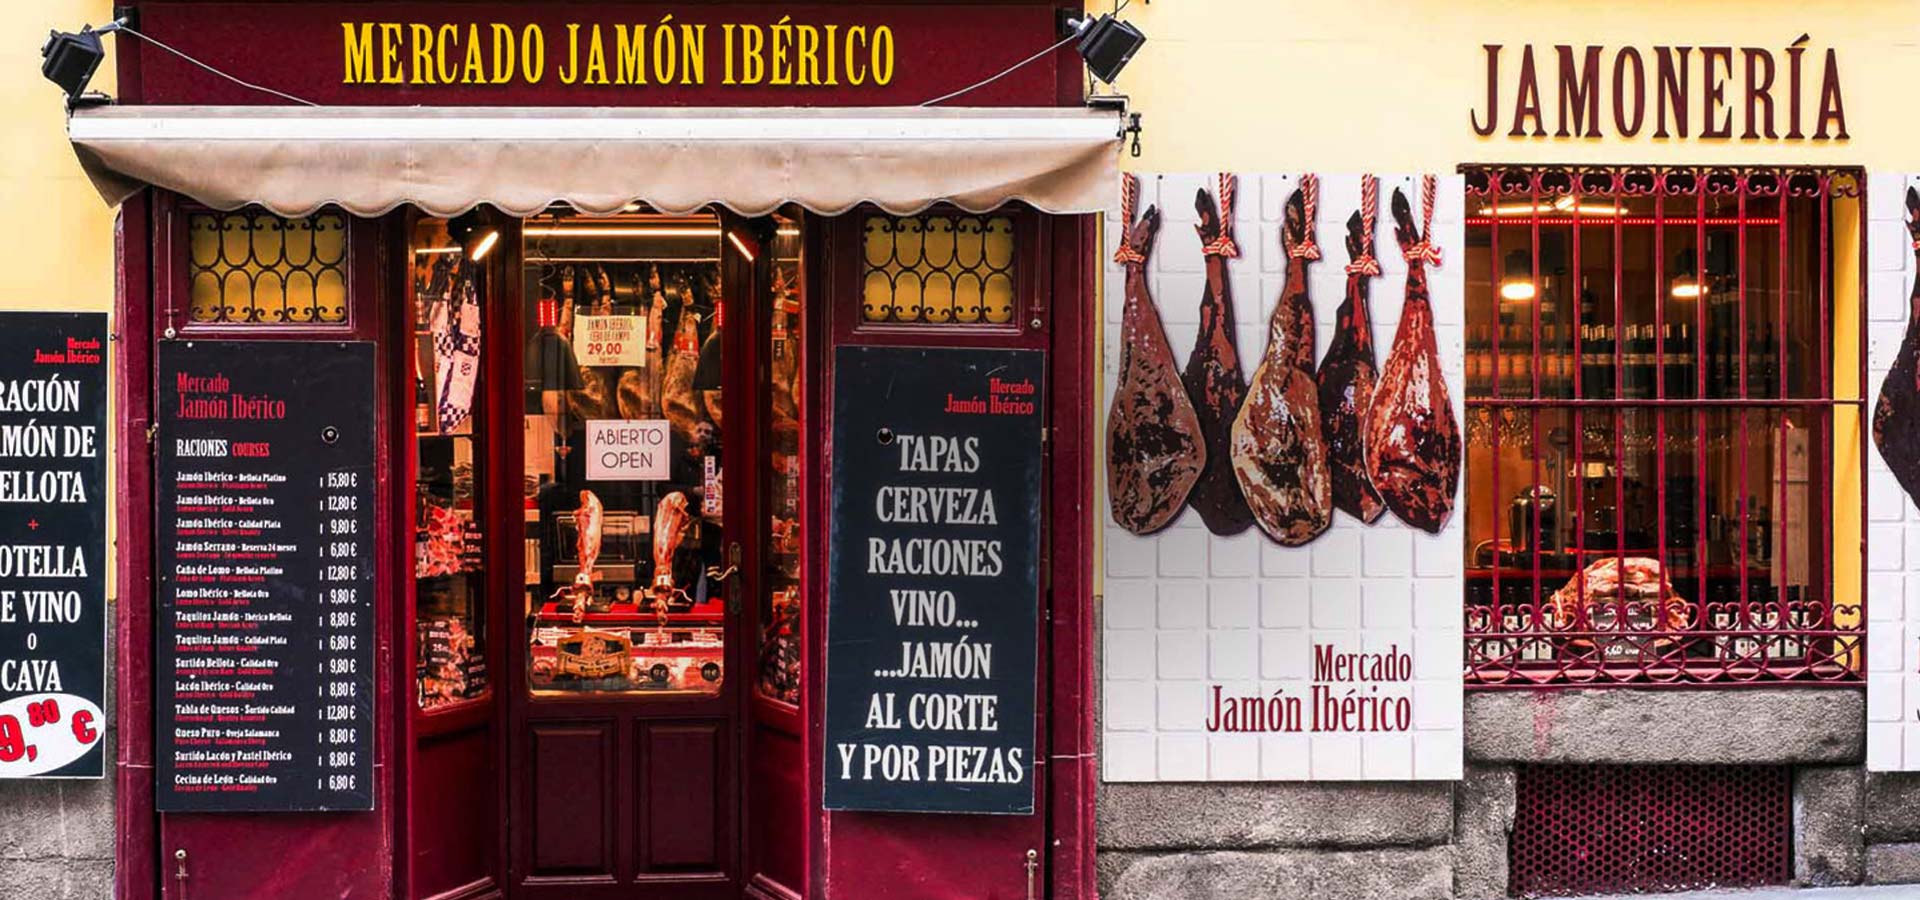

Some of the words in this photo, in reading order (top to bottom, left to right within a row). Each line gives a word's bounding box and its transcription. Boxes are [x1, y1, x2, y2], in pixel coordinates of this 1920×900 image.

[341, 22, 545, 85] MERCADO
[559, 14, 706, 86] JAMÓN
[722, 15, 895, 86] IBÉRICO
[1471, 33, 1850, 141] JAMONERÍA
[66, 337, 100, 350] Mercado
[34, 349, 65, 363] Jamón
[67, 349, 100, 363] Ibérico
[177, 372, 230, 393] Mercado
[990, 378, 1034, 394] Mercado
[176, 394, 228, 419] Jamón
[232, 394, 285, 419] Ibérico
[945, 393, 987, 413] Jamón
[990, 395, 1034, 414] Ibérico
[63, 425, 96, 458] DE
[595, 428, 664, 446] ABIERTO
[176, 439, 228, 457] RACIONES
[232, 442, 270, 457] COURSES
[897, 435, 979, 472] TAPAS
[601, 451, 653, 469] OPEN
[176, 472, 203, 481] Jamón
[204, 472, 233, 481] Ibérico
[327, 473, 349, 488] 15,80
[176, 495, 203, 504] Jamón
[204, 495, 233, 504] Ibérico
[239, 497, 261, 505] Bellota
[327, 496, 349, 512] 12,80
[876, 486, 997, 524] CERVEZA
[176, 518, 203, 528] Jamón
[204, 518, 233, 528] Ibérico
[239, 520, 262, 528] Calidad
[264, 520, 281, 528] Plata
[330, 519, 349, 535] 9,80
[176, 541, 203, 551] Jamón
[204, 542, 236, 551] Serrano
[330, 542, 349, 558] 6,80
[868, 538, 1002, 576] RACIONES
[176, 565, 196, 574] Caña
[197, 565, 207, 574] de
[208, 565, 230, 574] Lomo
[327, 566, 349, 581] 12,80
[176, 588, 198, 597] Lomo
[199, 588, 228, 597] Ibérico
[234, 590, 256, 598] Bellota
[330, 589, 349, 604] 9,80
[1, 590, 16, 623] E
[23, 590, 82, 623] VINO
[890, 590, 978, 628] VINO...
[176, 611, 211, 622] Taquitos
[212, 611, 239, 621] Jamón
[245, 613, 268, 621] Ibérico
[269, 613, 292, 621] Bellota
[330, 612, 349, 628] 8,80
[176, 635, 211, 645] Taquitos
[212, 635, 239, 644] Jamón
[245, 636, 269, 644] Calidad
[270, 636, 287, 644] Plata
[330, 635, 348, 651] 6,80
[175, 658, 205, 667] Surtido
[206, 658, 234, 667] Bellota
[241, 658, 266, 667] Calidad
[330, 659, 348, 674] 9,80
[874, 635, 992, 679] ...JAMÓN
[1314, 644, 1412, 682] Mercado
[1, 659, 62, 692] CAVA
[175, 681, 200, 691] Lacón
[201, 681, 230, 691] Ibérico
[236, 681, 260, 691] Calidad
[330, 682, 348, 698] 8,80
[175, 704, 199, 714] Tabla
[200, 704, 209, 714] de
[210, 704, 239, 714] Quesos
[245, 704, 270, 714] Surtido
[270, 706, 295, 714] Calidad
[327, 705, 348, 721] 12,80
[866, 693, 901, 730] AL
[908, 693, 998, 731] CORTE
[1206, 686, 1302, 733] Jamón
[1311, 685, 1411, 732] Ibérico
[72, 709, 97, 744] €
[175, 728, 200, 737] Queso
[201, 728, 220, 737] Puro
[244, 729, 280, 737] Salamanca
[329, 728, 348, 744] 8,80
[175, 751, 205, 760] Surtido
[206, 751, 230, 760] Lacón
[231, 753, 236, 762] y
[237, 751, 261, 760] Pastel
[263, 751, 292, 760] Ibérico
[329, 752, 348, 768] 8,80
[838, 744, 856, 781] Y
[863, 744, 920, 781] POR
[928, 747, 1023, 784] PIEZAS
[175, 774, 201, 784] Cecina
[203, 774, 213, 784] de
[214, 774, 233, 784] León
[239, 774, 264, 783] Calidad
[329, 775, 348, 791] 6,80
